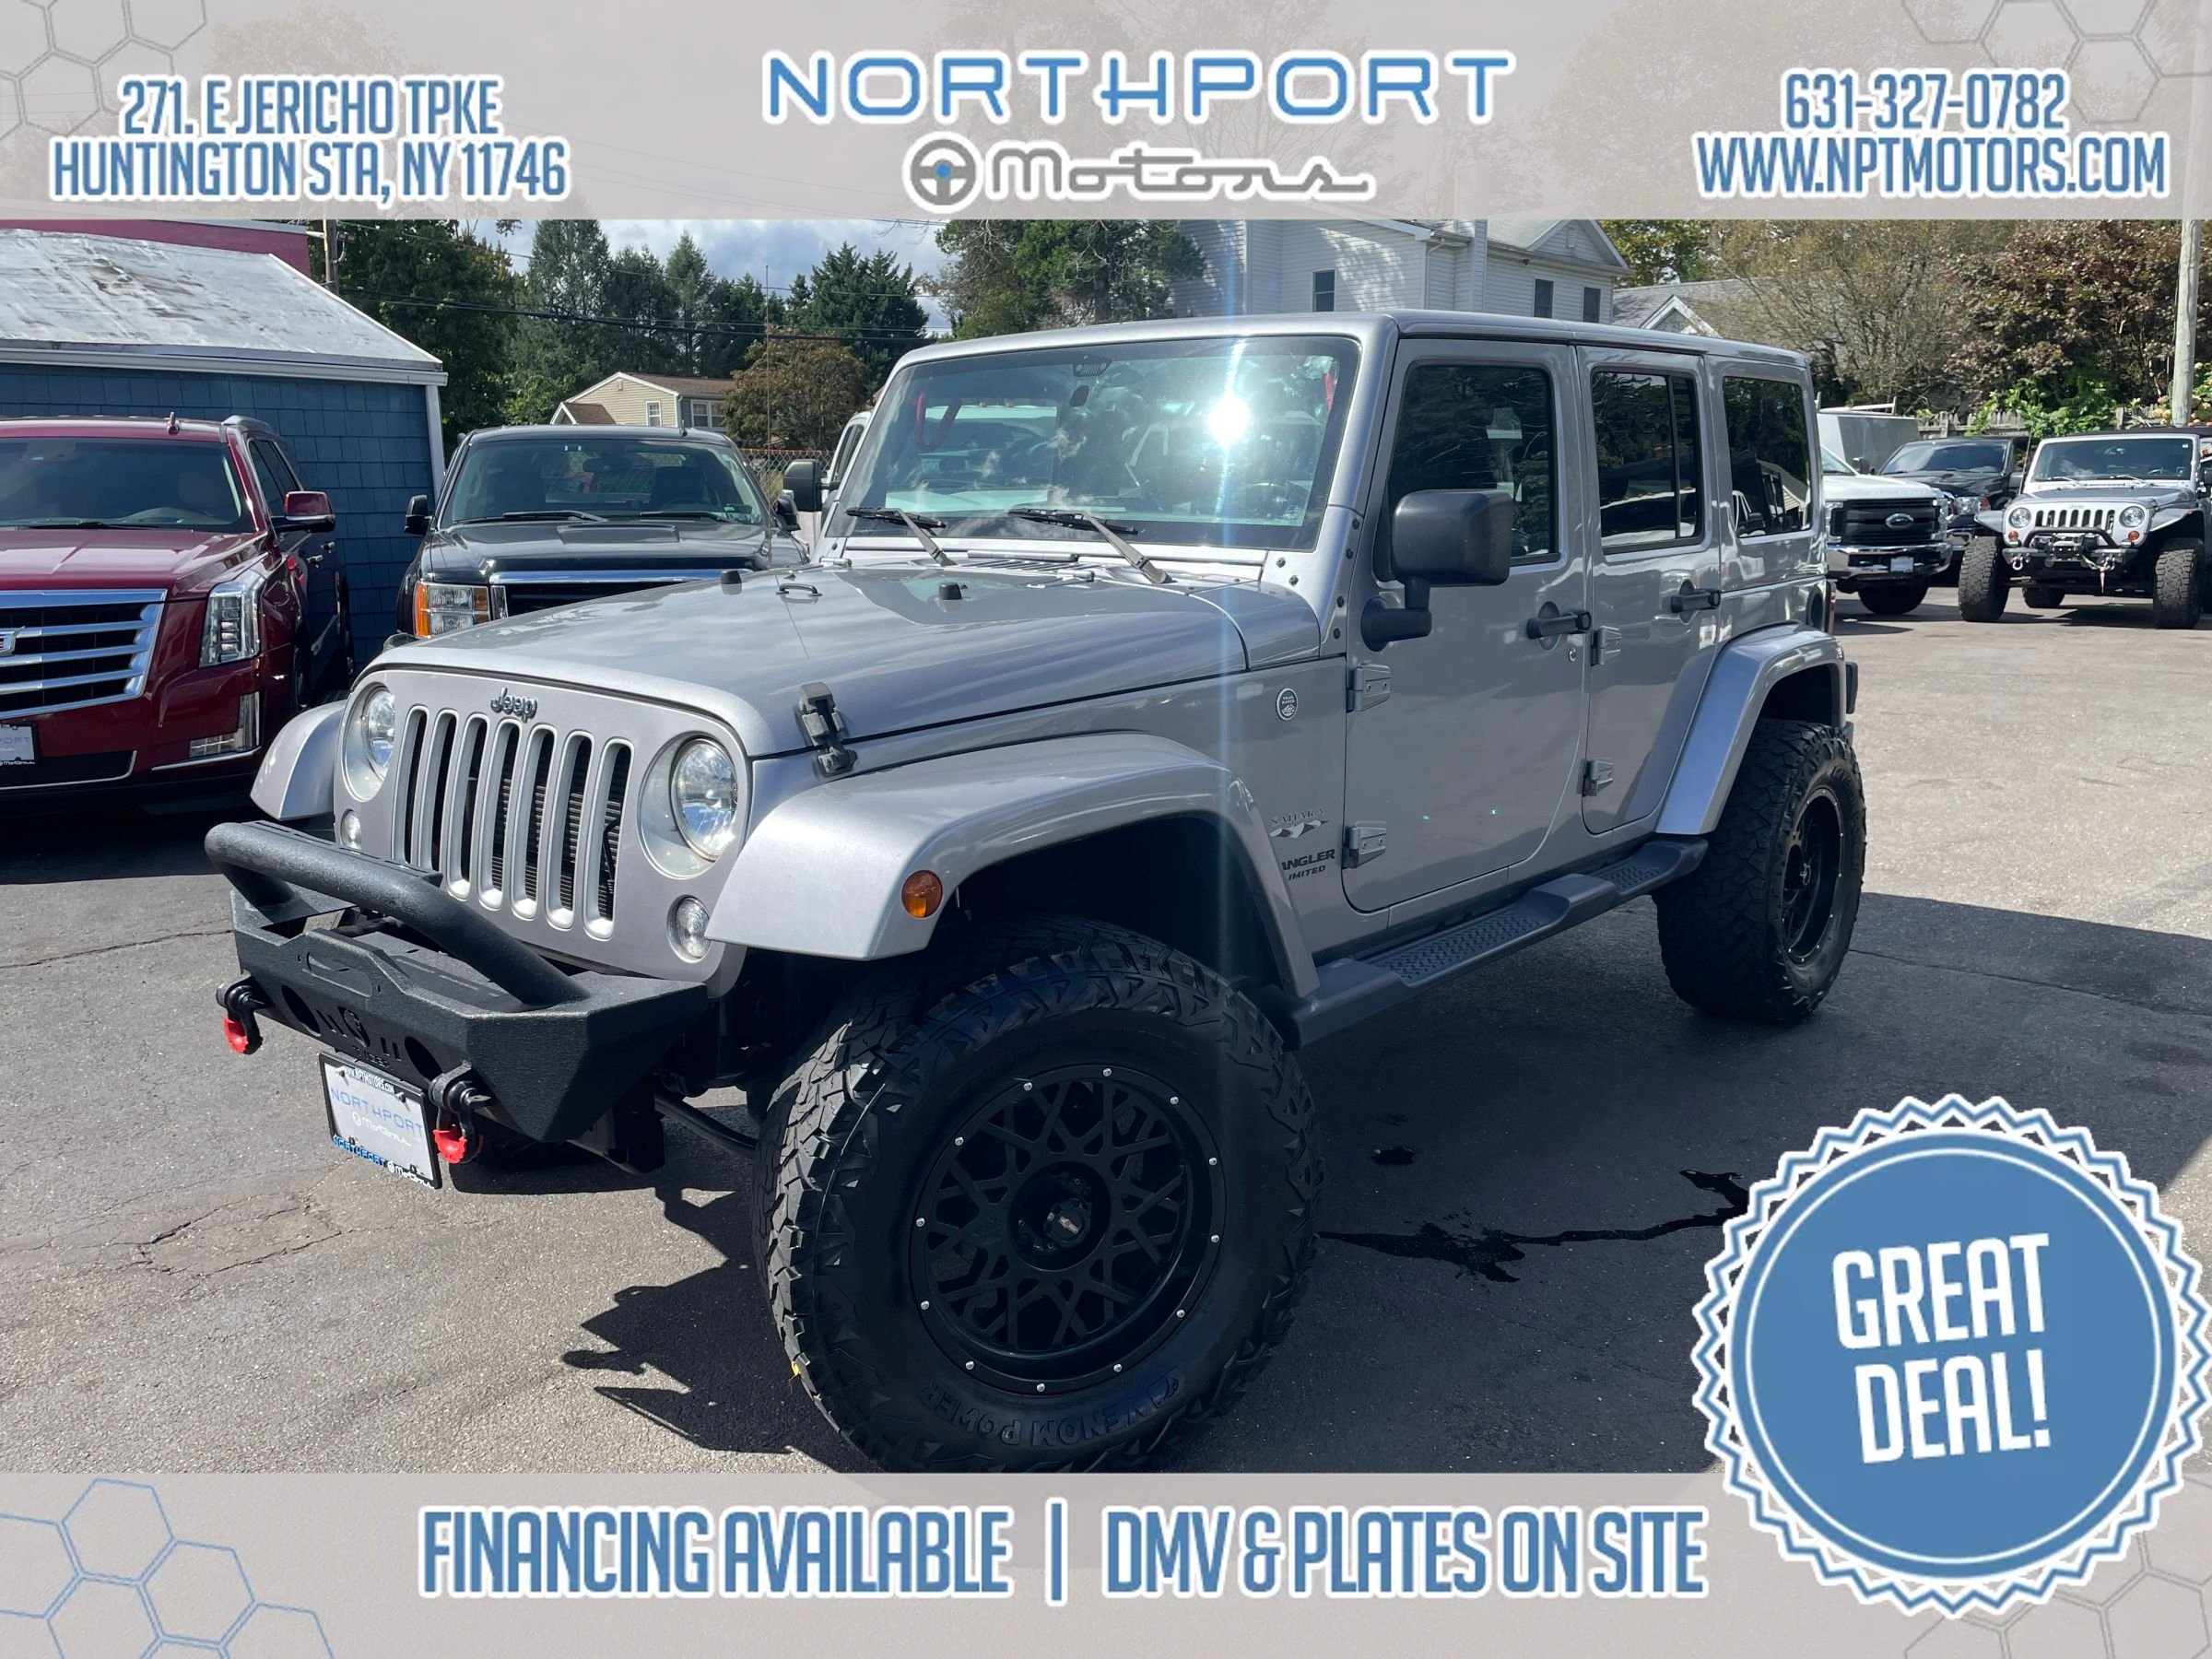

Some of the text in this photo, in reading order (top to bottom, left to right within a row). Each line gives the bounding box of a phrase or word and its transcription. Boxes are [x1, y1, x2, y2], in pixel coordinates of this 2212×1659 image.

[490, 687, 537, 724] Jeep
[1288, 865, 1326, 881] IMITED
[330, 1089, 425, 1138] NORTHPORT
[332, 1134, 385, 1168] NORTHPORT
